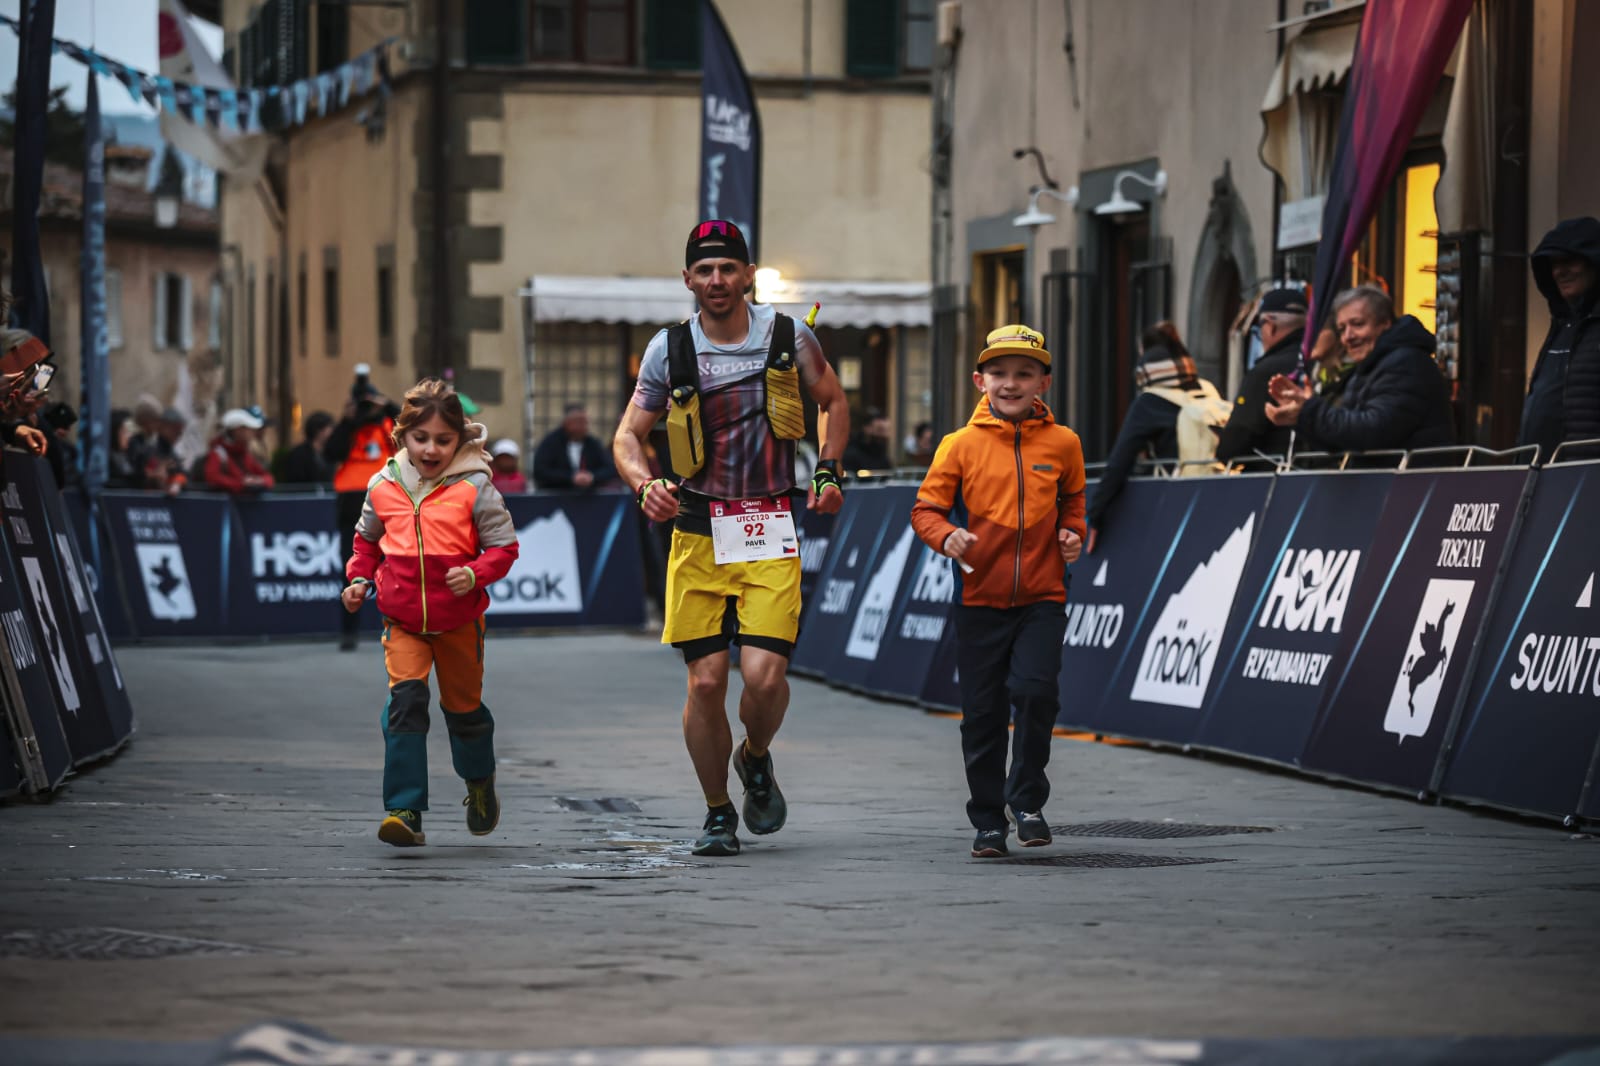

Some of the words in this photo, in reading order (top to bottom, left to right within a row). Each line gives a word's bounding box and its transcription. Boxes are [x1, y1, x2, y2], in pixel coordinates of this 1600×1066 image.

[736, 513, 770, 523] UTCC120
[743, 522, 765, 537] 92
[1447, 503, 1499, 532] REGIONE
[251, 532, 342, 577] HOK
[745, 539, 767, 548] PAVEL
[1437, 538, 1486, 568] TOSCANA
[1258, 547, 1361, 634] HOKA
[1145, 618, 1212, 687] näak
[1242, 646, 1268, 678] FLY
[1261, 648, 1311, 684] HUMAN
[1303, 652, 1332, 686] FLY
